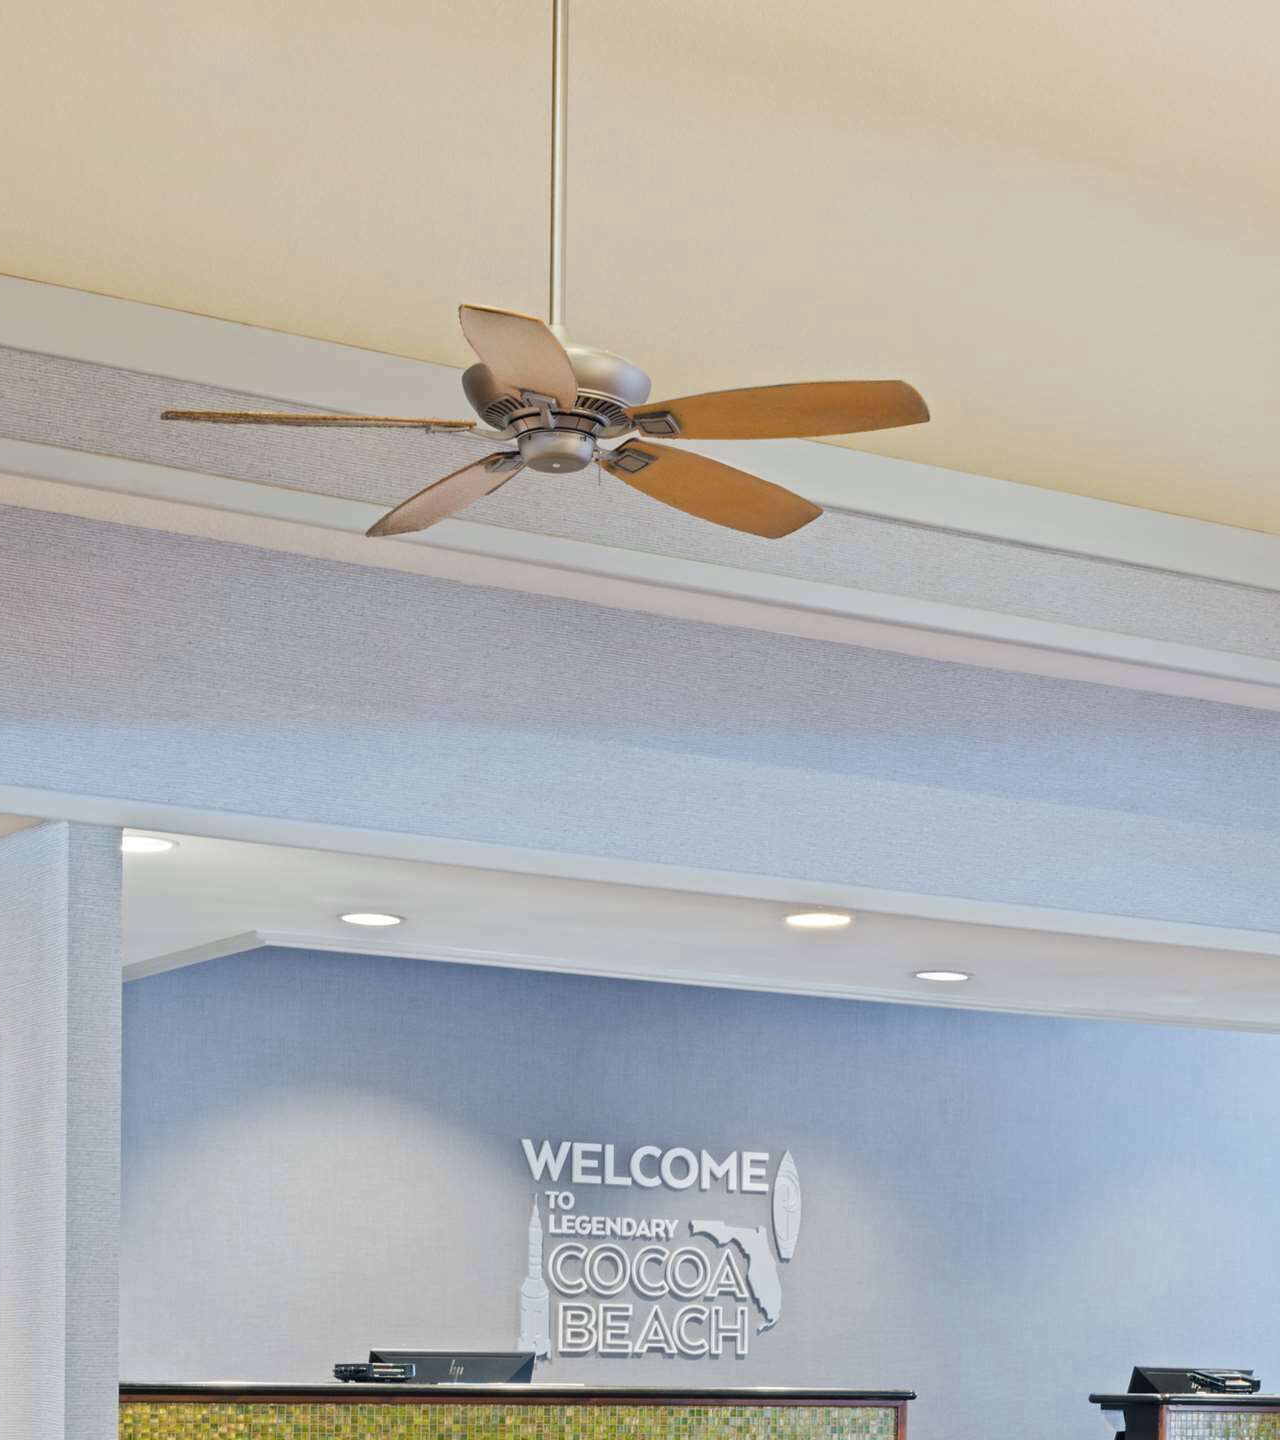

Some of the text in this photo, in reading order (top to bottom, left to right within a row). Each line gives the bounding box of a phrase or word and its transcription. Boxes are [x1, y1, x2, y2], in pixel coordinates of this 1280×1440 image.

[521, 1138, 770, 1192] WELCOME
[545, 1191, 575, 1210] TO
[549, 1215, 679, 1239] LEGENDARY
[548, 1242, 751, 1300] COCOA
[558, 1303, 749, 1357] BEACH
